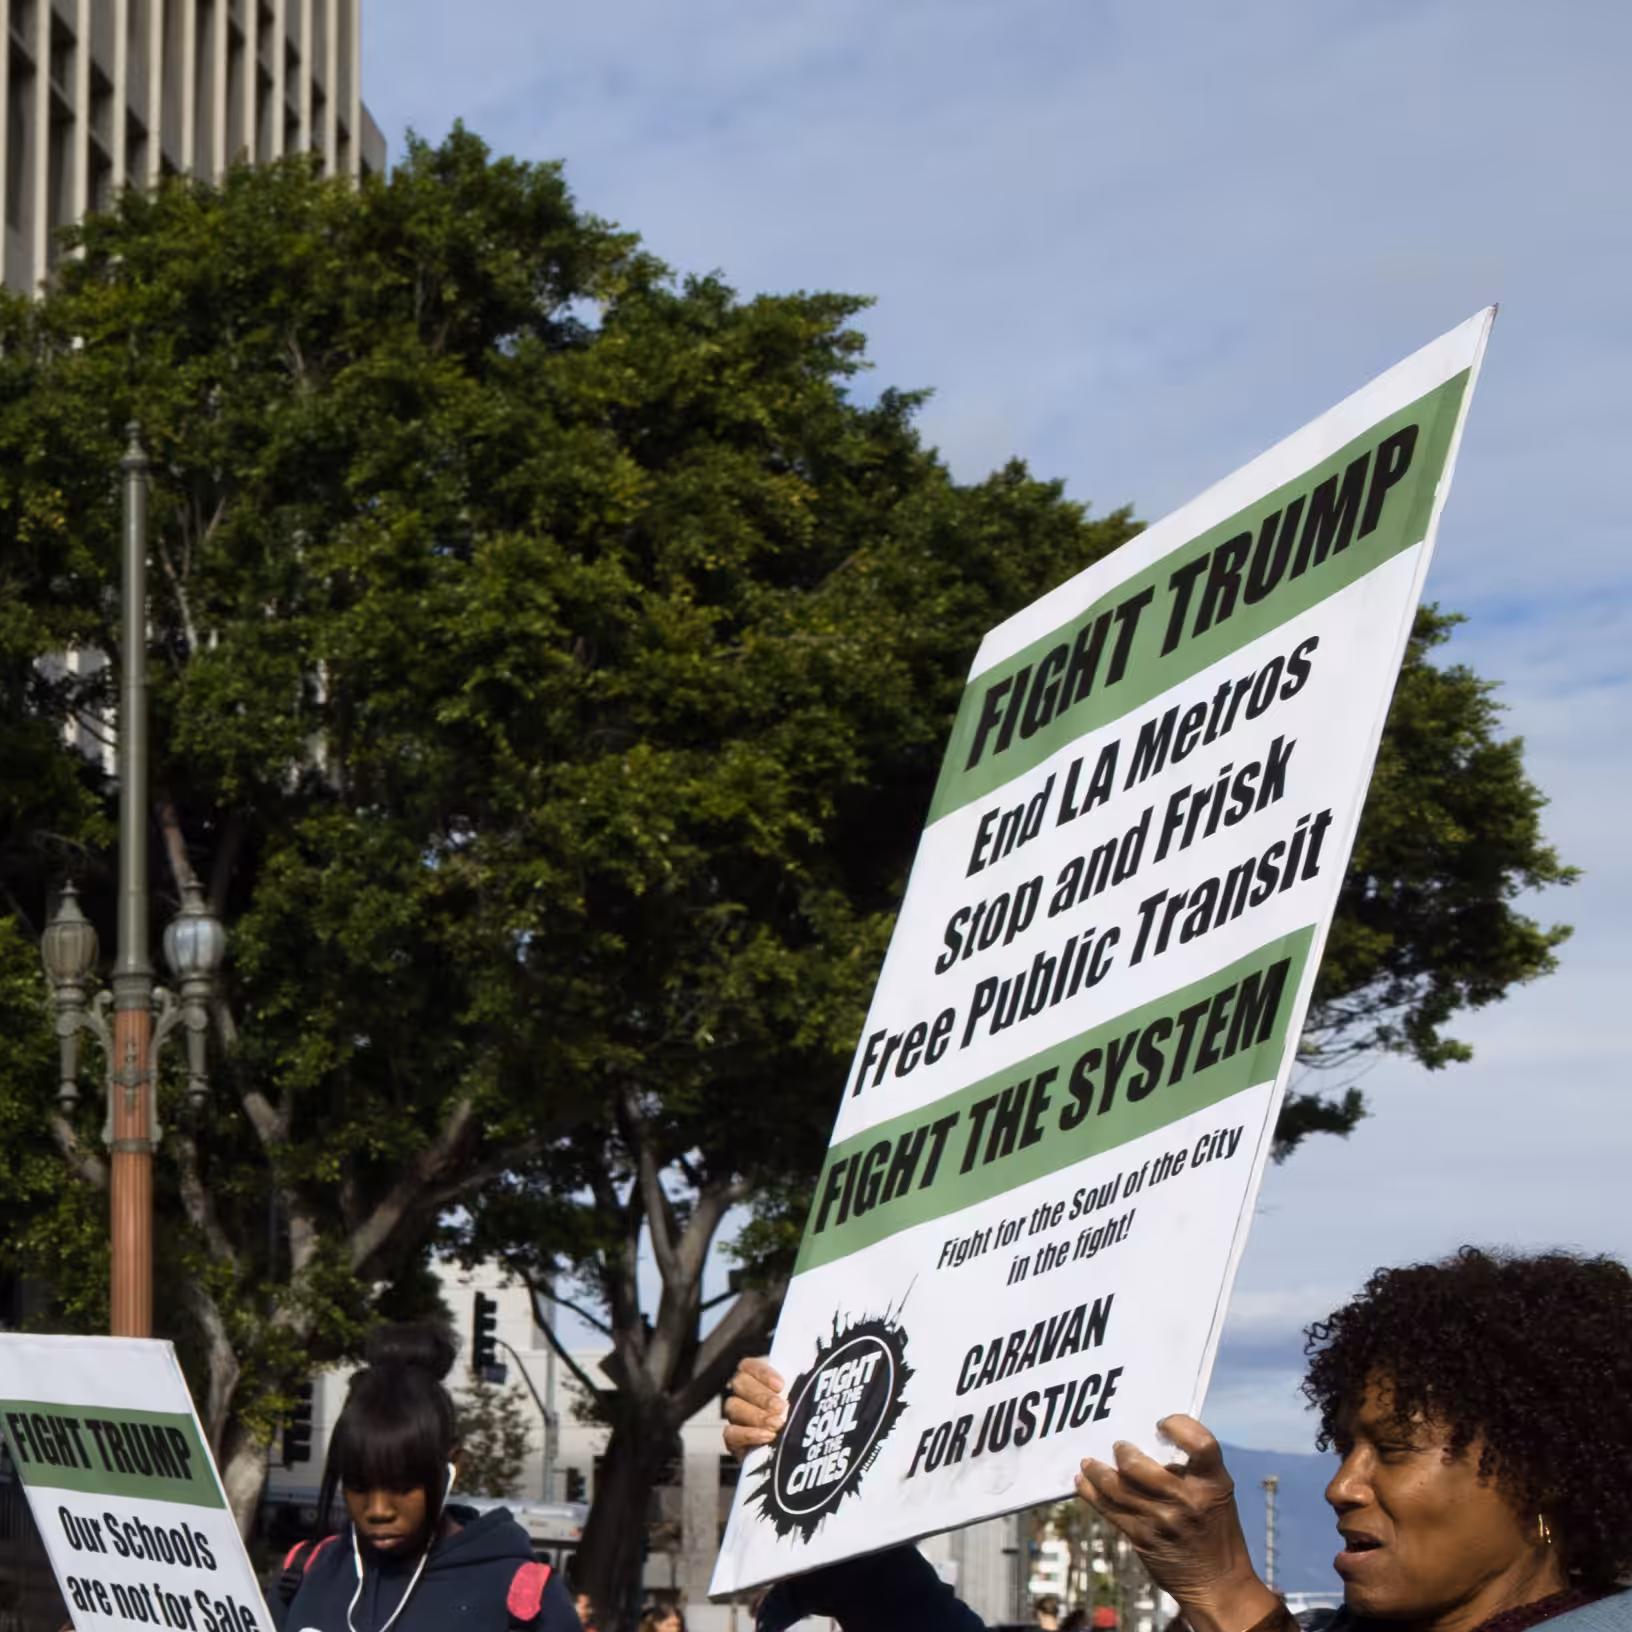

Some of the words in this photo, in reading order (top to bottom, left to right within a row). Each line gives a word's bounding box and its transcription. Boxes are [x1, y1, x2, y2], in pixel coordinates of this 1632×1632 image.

[963, 584, 1156, 773] FIGHT
[1160, 423, 1420, 659] TRUMP
[965, 772, 1057, 878] End
[1055, 739, 1121, 828] LA
[1123, 635, 1320, 792] Metros
[934, 874, 1044, 975] Stop
[1048, 805, 1155, 918] and
[1152, 734, 1297, 865] Frisk
[851, 1007, 956, 1098] Free
[960, 926, 1121, 1050] Public
[1128, 808, 1333, 968] Transit
[812, 1110, 960, 1235] FIGHT
[959, 1065, 1059, 1175] THE
[1058, 957, 1292, 1131] SYSTEM
[936, 1226, 992, 1271] Fight
[993, 1216, 1027, 1250] for
[1028, 1199, 1065, 1236] the
[1068, 1173, 1122, 1221] Soul
[1123, 1166, 1148, 1198] of
[1148, 1148, 1188, 1188] the
[1191, 1125, 1244, 1170] City
[1006, 1255, 1027, 1286] in
[1032, 1239, 1070, 1277] the
[1072, 1208, 1136, 1261] fight!
[813, 1350, 883, 1402] FIGHT
[956, 1293, 1115, 1396] CARAVAN
[802, 1402, 858, 1447] SOUL
[816, 1394, 840, 1415] FOR
[841, 1385, 864, 1404] THE
[907, 1413, 974, 1479] FOR
[970, 1365, 1124, 1458] JUSTICE
[5, 1412, 93, 1469] FIGHT
[84, 1418, 193, 1480] TRUMP
[786, 1447, 851, 1495] CITIES
[807, 1443, 824, 1461] OF
[58, 1505, 108, 1554] Our
[102, 1511, 217, 1571] Schools
[66, 1575, 113, 1617] are
[110, 1582, 161, 1626] not
[153, 1582, 197, 1632] for
